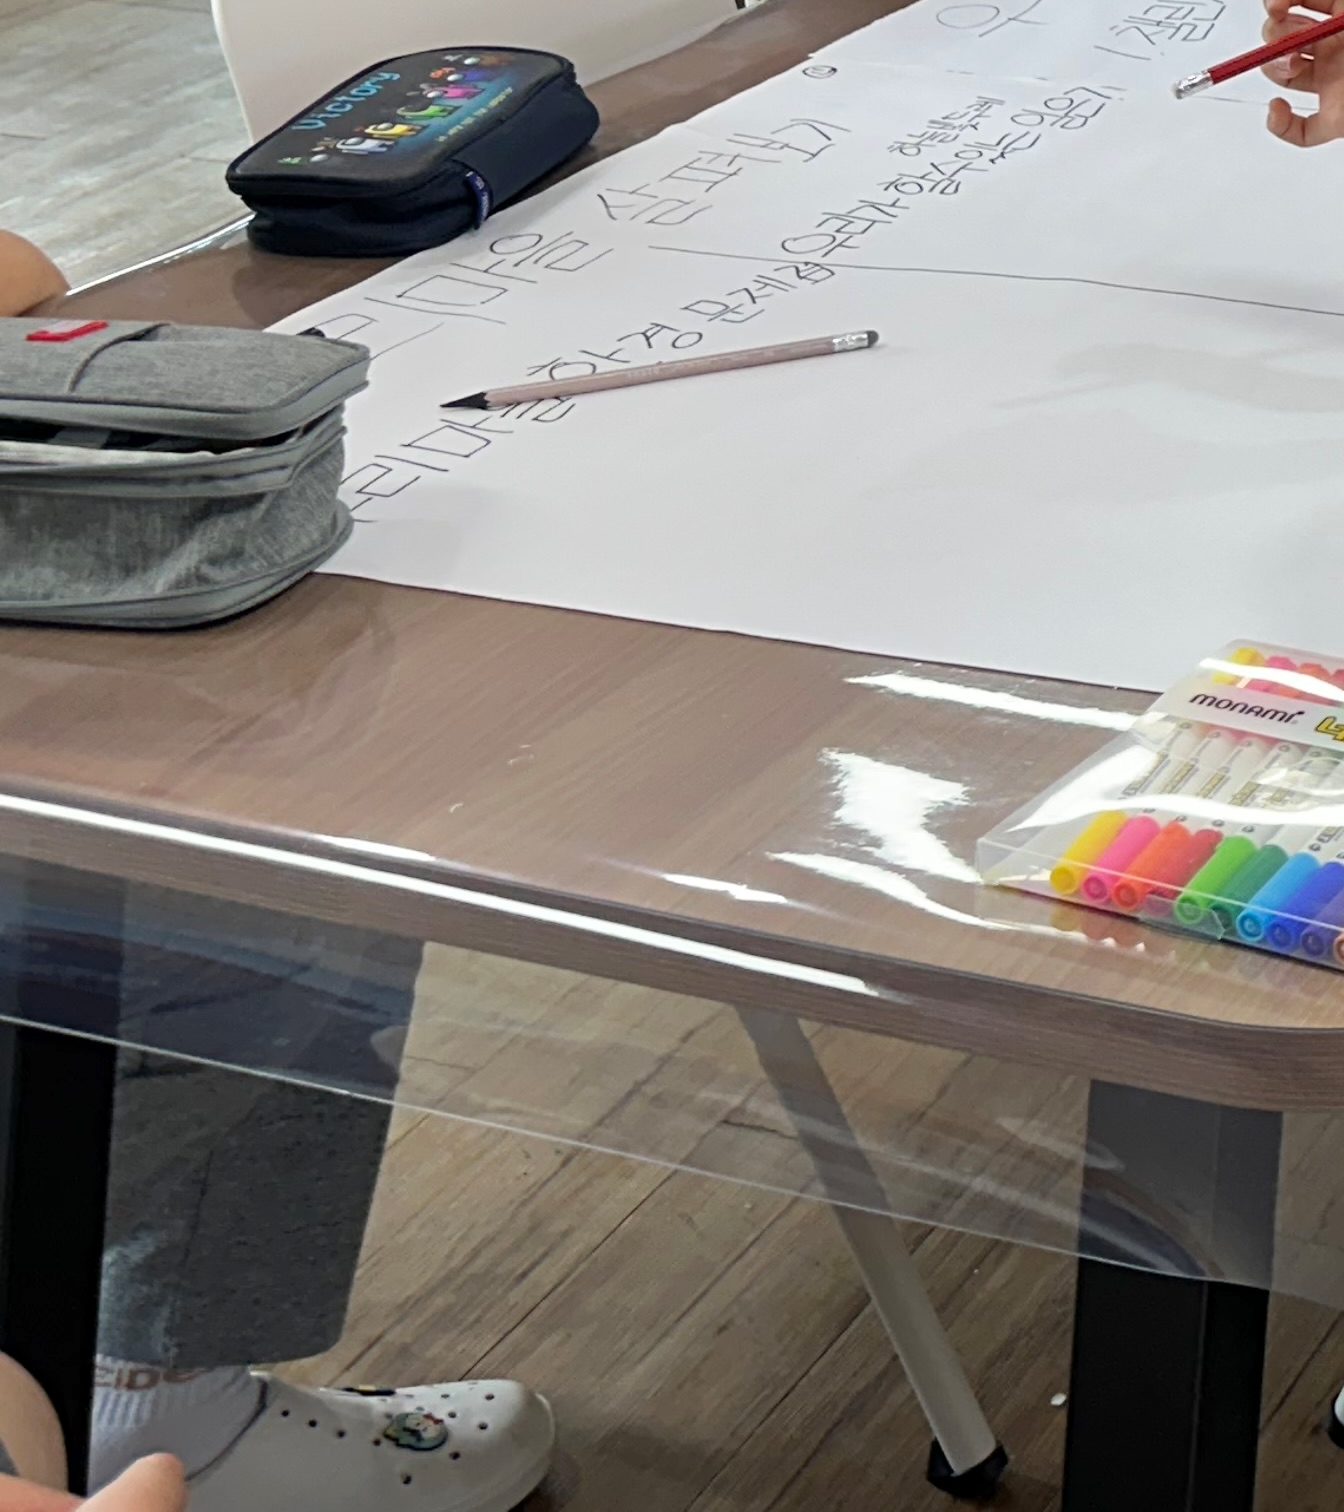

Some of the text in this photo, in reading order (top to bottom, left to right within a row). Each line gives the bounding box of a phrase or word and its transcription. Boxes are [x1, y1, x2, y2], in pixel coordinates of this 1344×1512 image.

[292, 69, 400, 131] Victory
[780, 197, 911, 258] 우리가
[1189, 693, 1305, 725] monami
